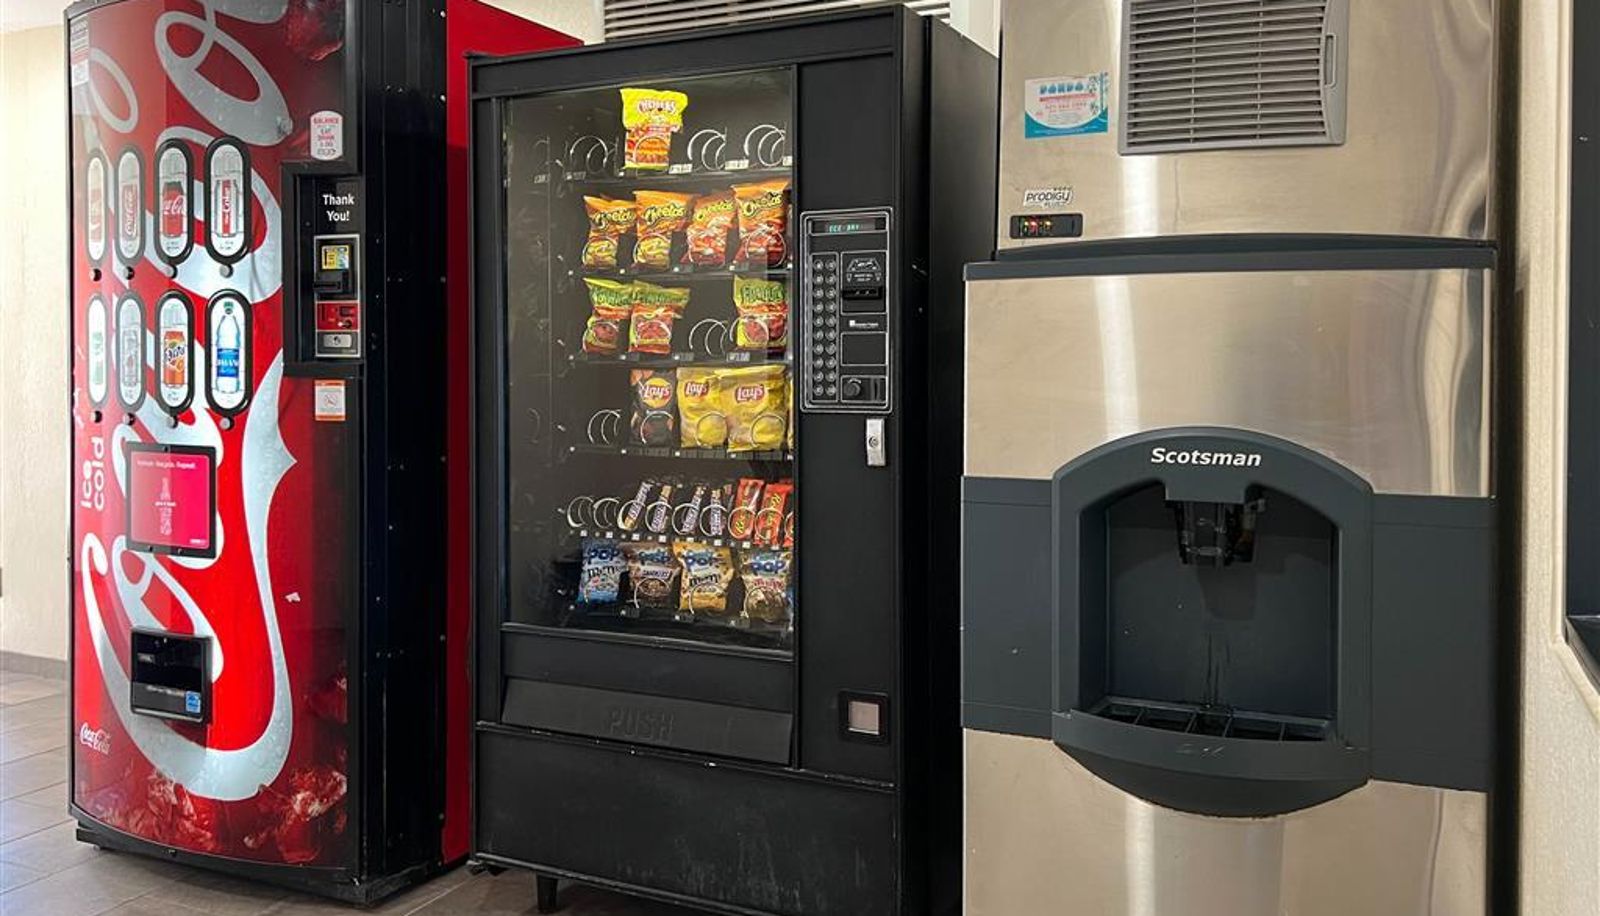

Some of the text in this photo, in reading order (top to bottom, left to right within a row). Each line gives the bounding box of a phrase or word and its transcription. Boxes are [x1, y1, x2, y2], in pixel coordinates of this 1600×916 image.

[322, 193, 355, 206] Thank
[326, 210, 350, 221] You!
[1150, 447, 1262, 467] Scotsman
[91, 436, 104, 512] cold
